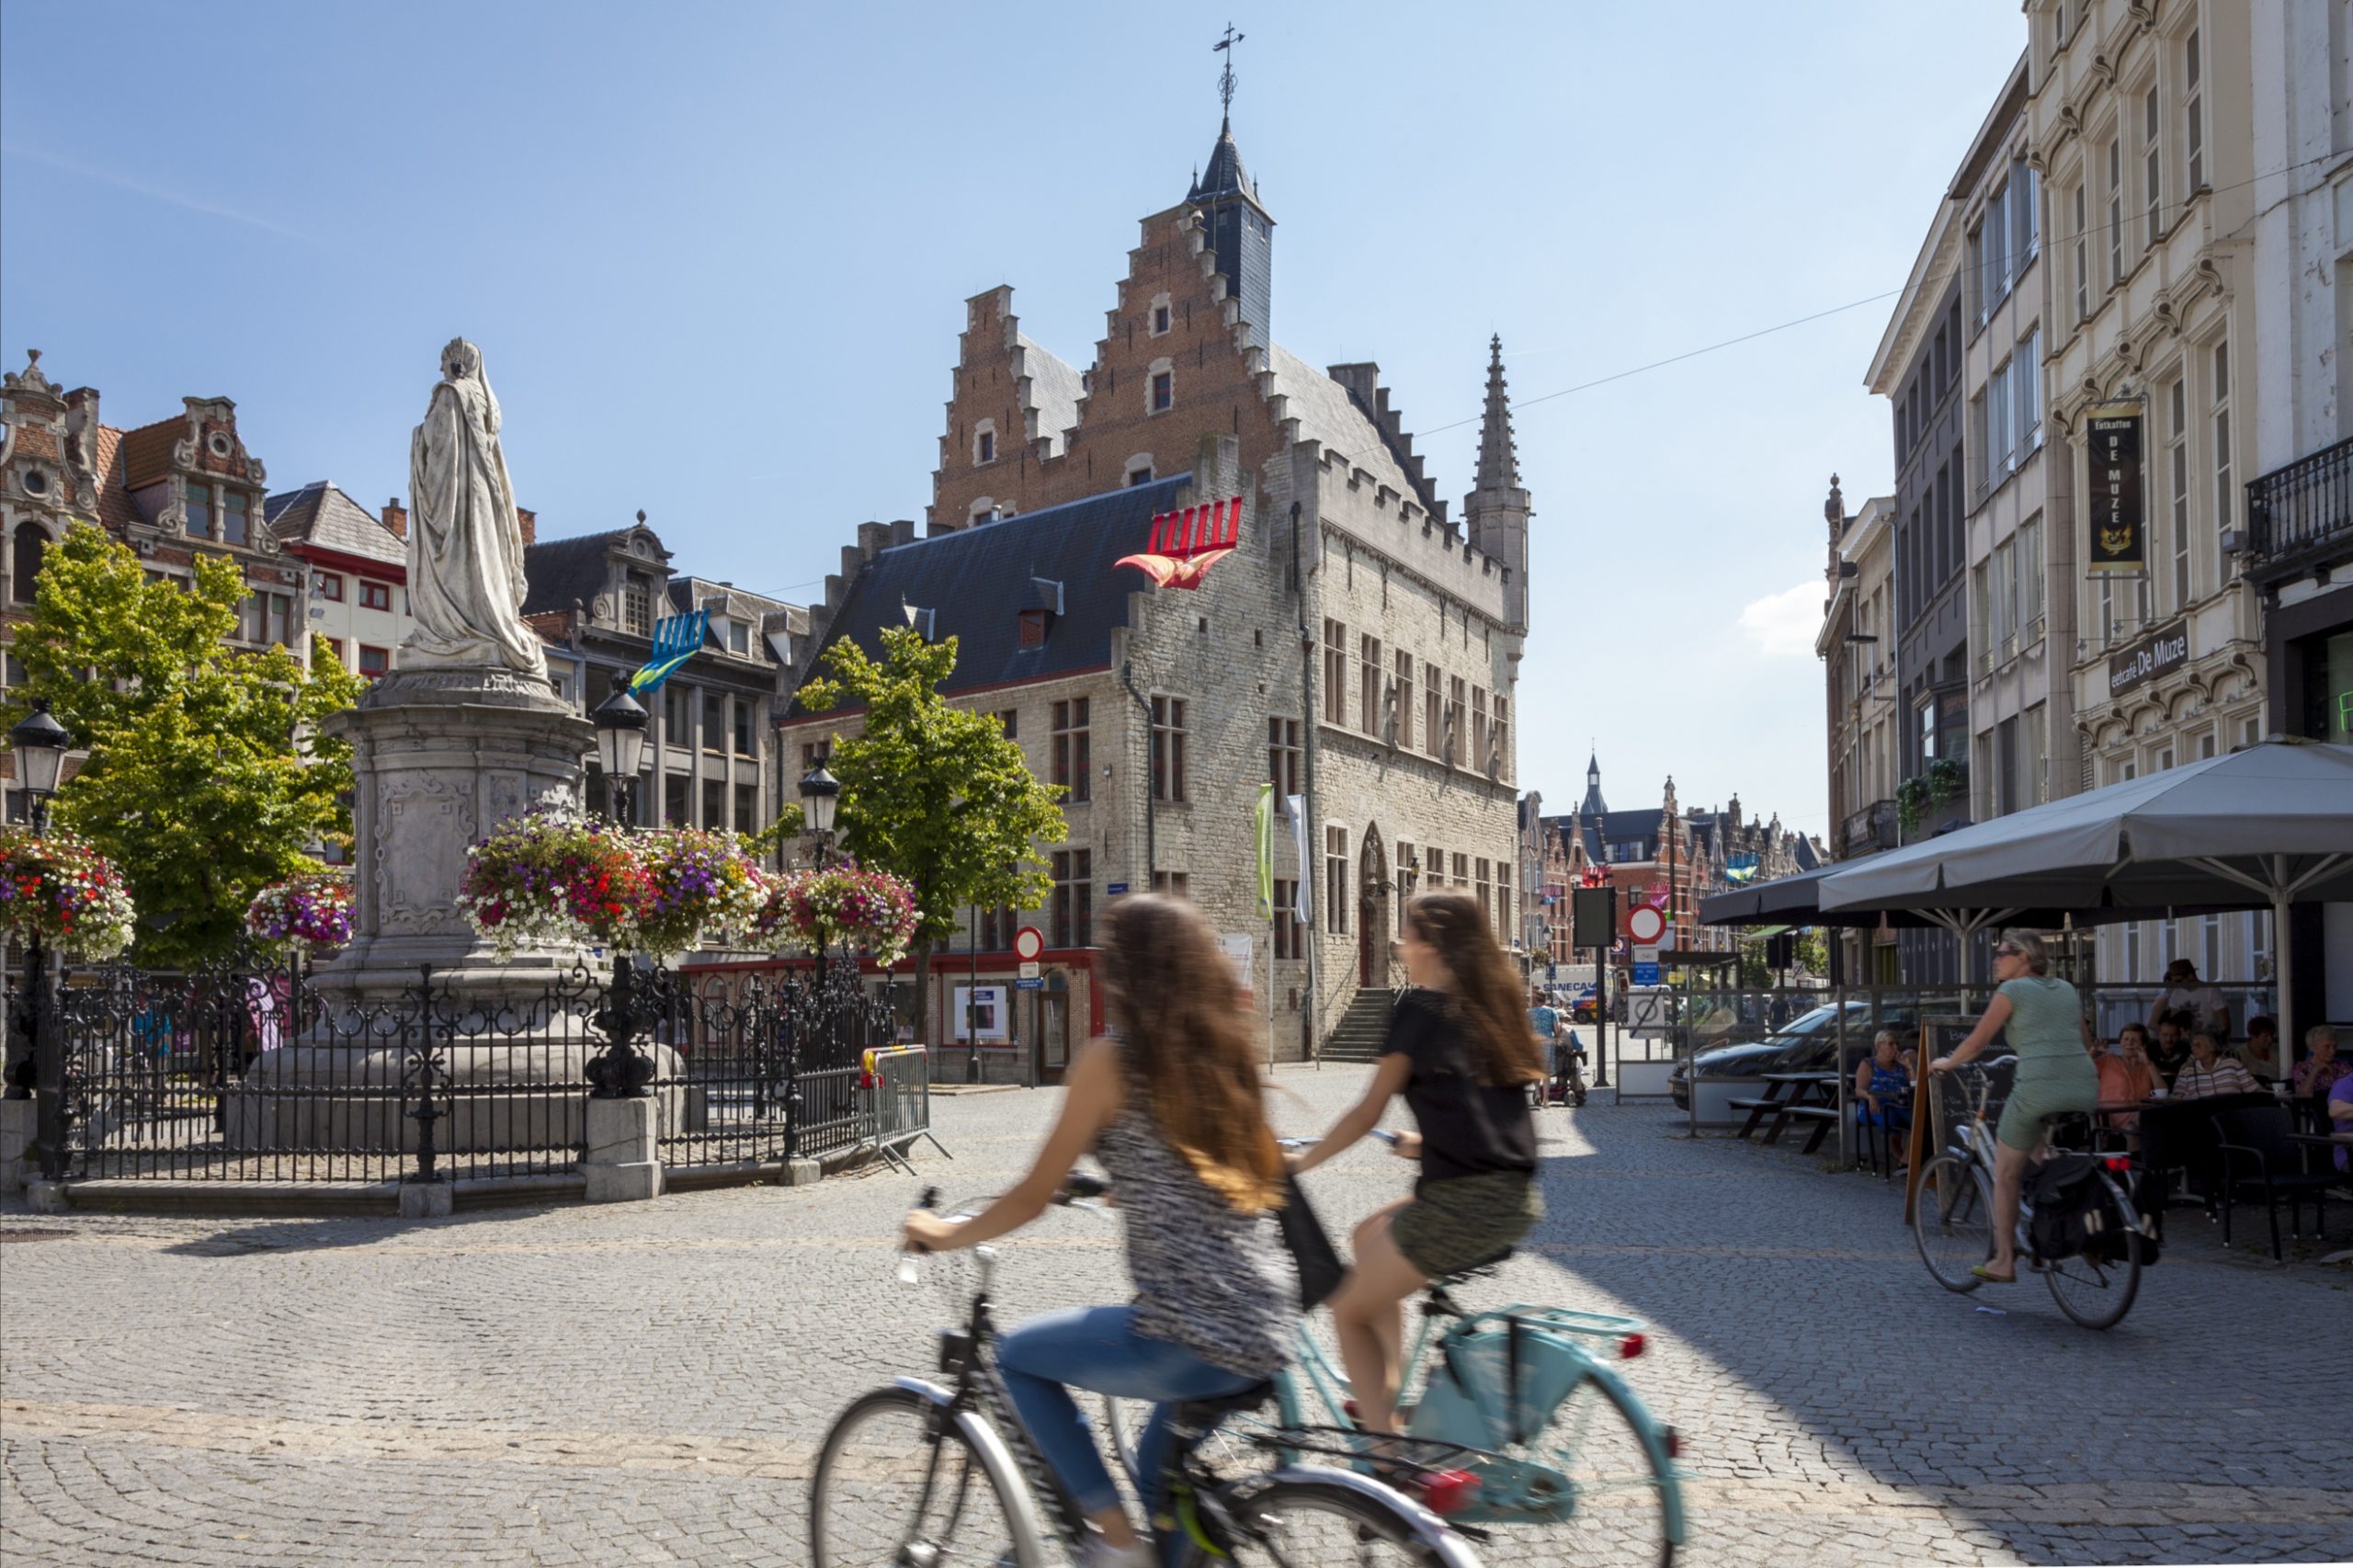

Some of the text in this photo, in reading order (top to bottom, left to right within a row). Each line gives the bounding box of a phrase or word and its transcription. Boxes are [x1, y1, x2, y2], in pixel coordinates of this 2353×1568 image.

[2108, 436, 2121, 523] DE MUZE
[2111, 636, 2185, 687] eetcafé De Muze
